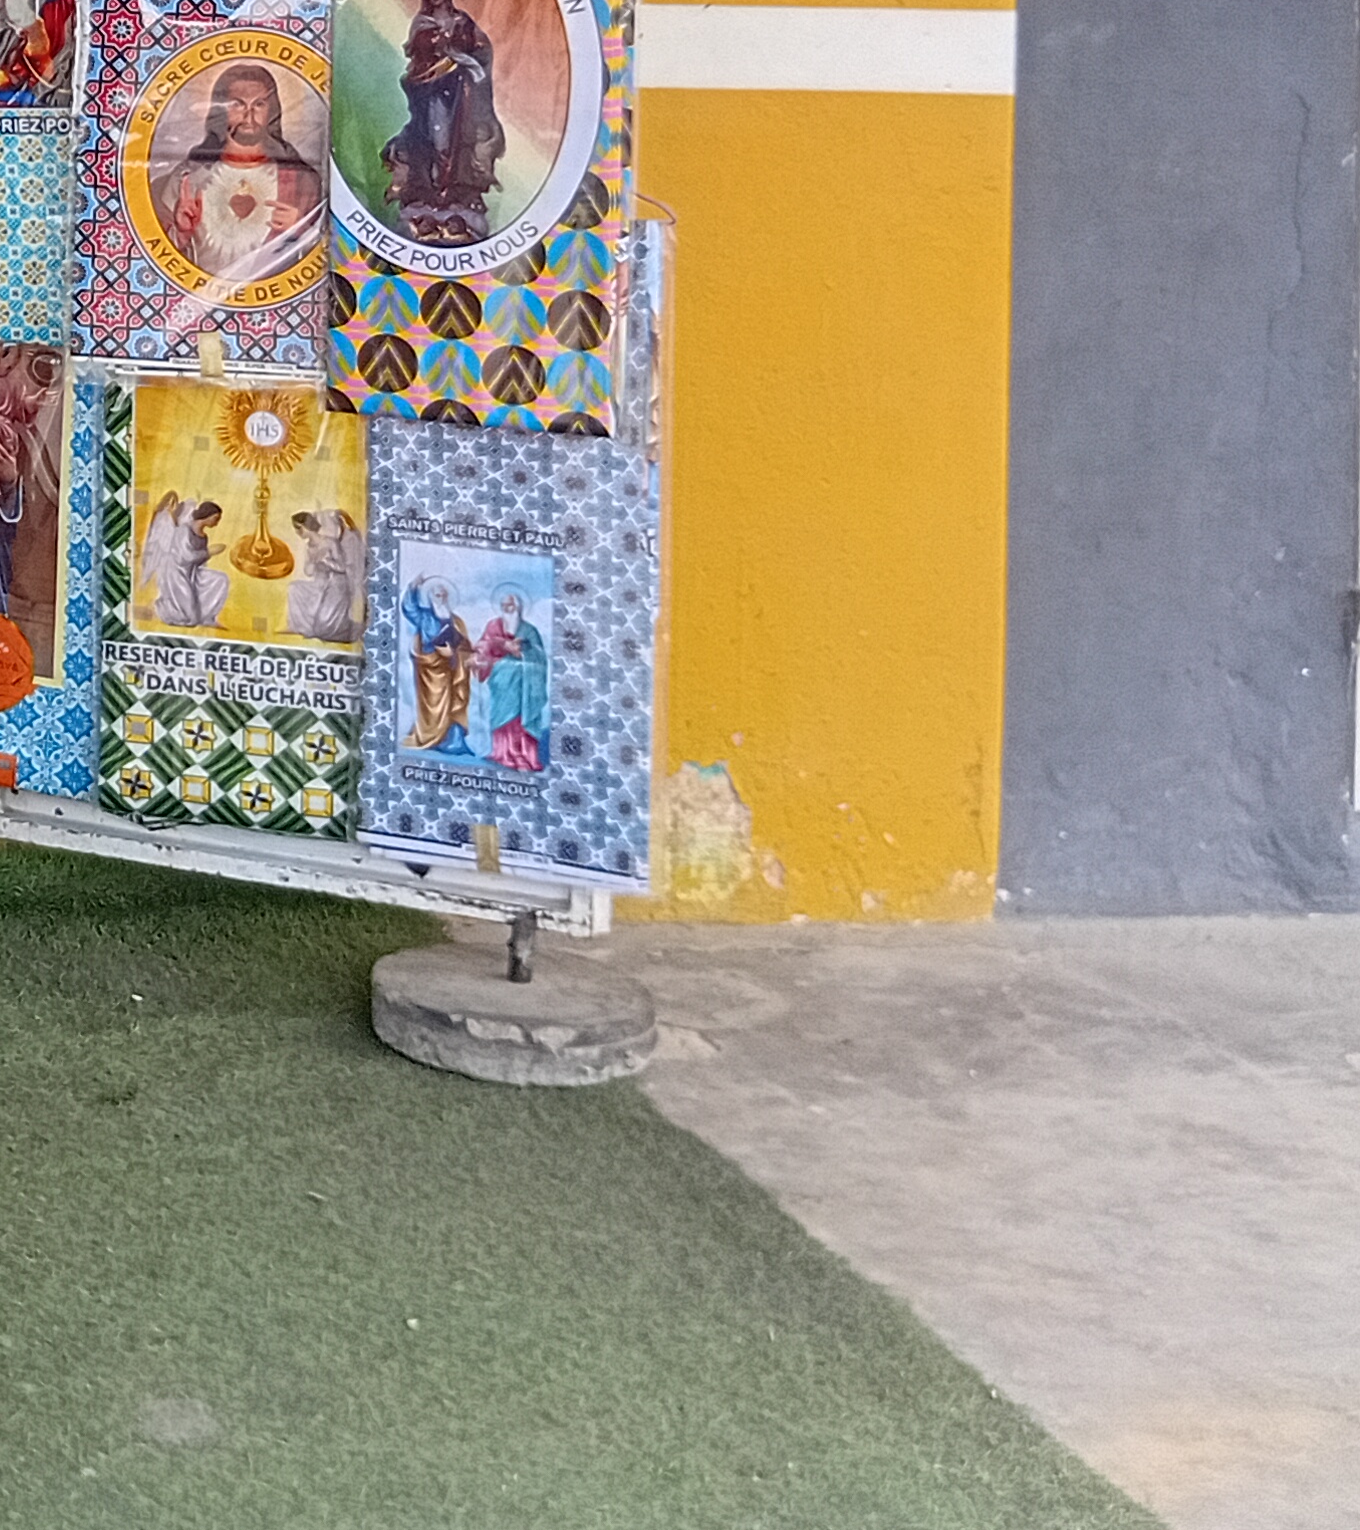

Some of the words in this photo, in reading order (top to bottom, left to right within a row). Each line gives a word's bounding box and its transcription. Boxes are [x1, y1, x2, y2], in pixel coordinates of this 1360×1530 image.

[140, 59, 194, 124] SACRE
[277, 46, 308, 71] DE
[45, 118, 71, 134] PO
[346, 209, 408, 261] PRIEZ
[408, 251, 476, 272] POUR
[479, 220, 539, 267] NOUS
[145, 237, 192, 282] AYEZ
[254, 281, 283, 302] DE
[287, 253, 327, 291] NOU
[388, 516, 441, 533] SAINTS
[444, 523, 498, 541] PIERRE
[502, 529, 521, 543] ET
[525, 531, 564, 548] PAUL
[102, 642, 197, 669] RESENCE
[204, 645, 253, 675] RÉEL
[259, 658, 288, 678] DE
[292, 656, 360, 686] JÉSUS
[146, 673, 207, 695] DANS
[404, 767, 447, 783] PRIEZ
[451, 774, 492, 791] POUR
